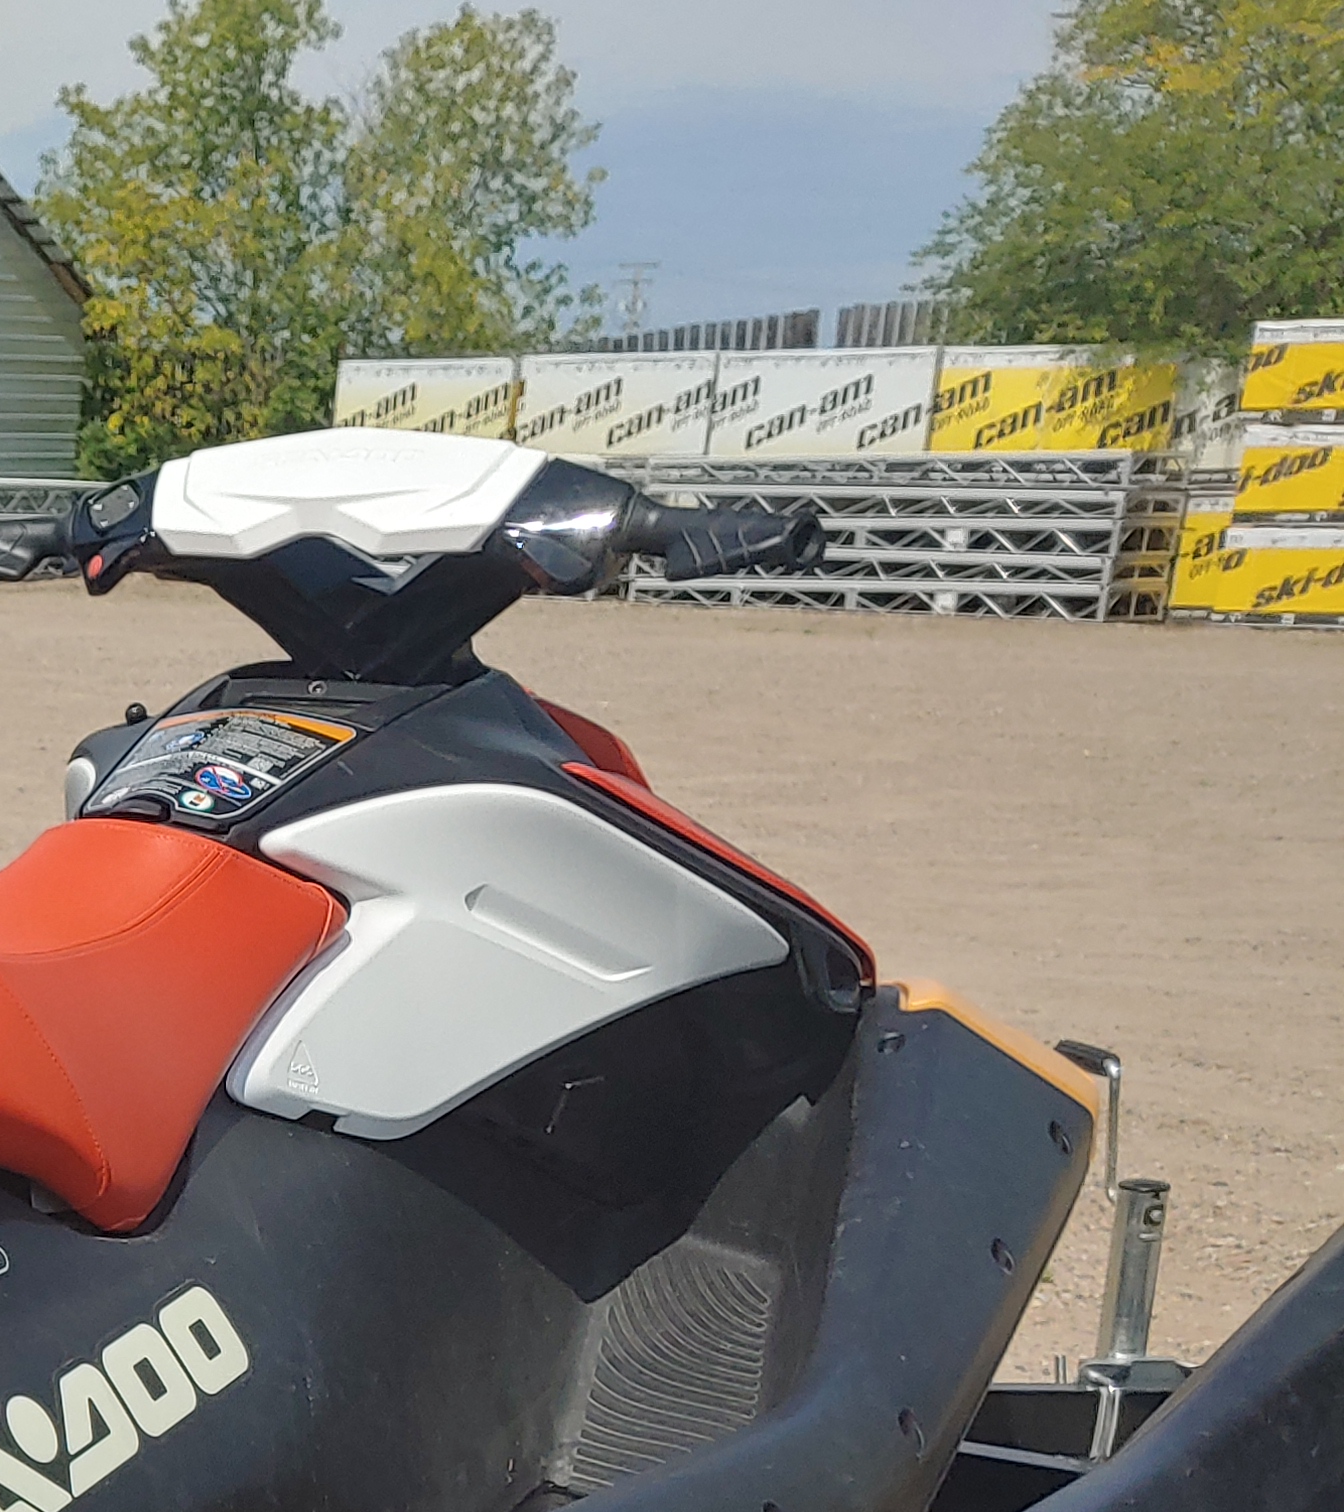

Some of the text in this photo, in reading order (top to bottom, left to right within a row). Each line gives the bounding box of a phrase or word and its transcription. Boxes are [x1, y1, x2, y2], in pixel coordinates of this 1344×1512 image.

[517, 374, 622, 441] can-am
[744, 373, 875, 450] can-am
[973, 369, 1118, 449] can-am
